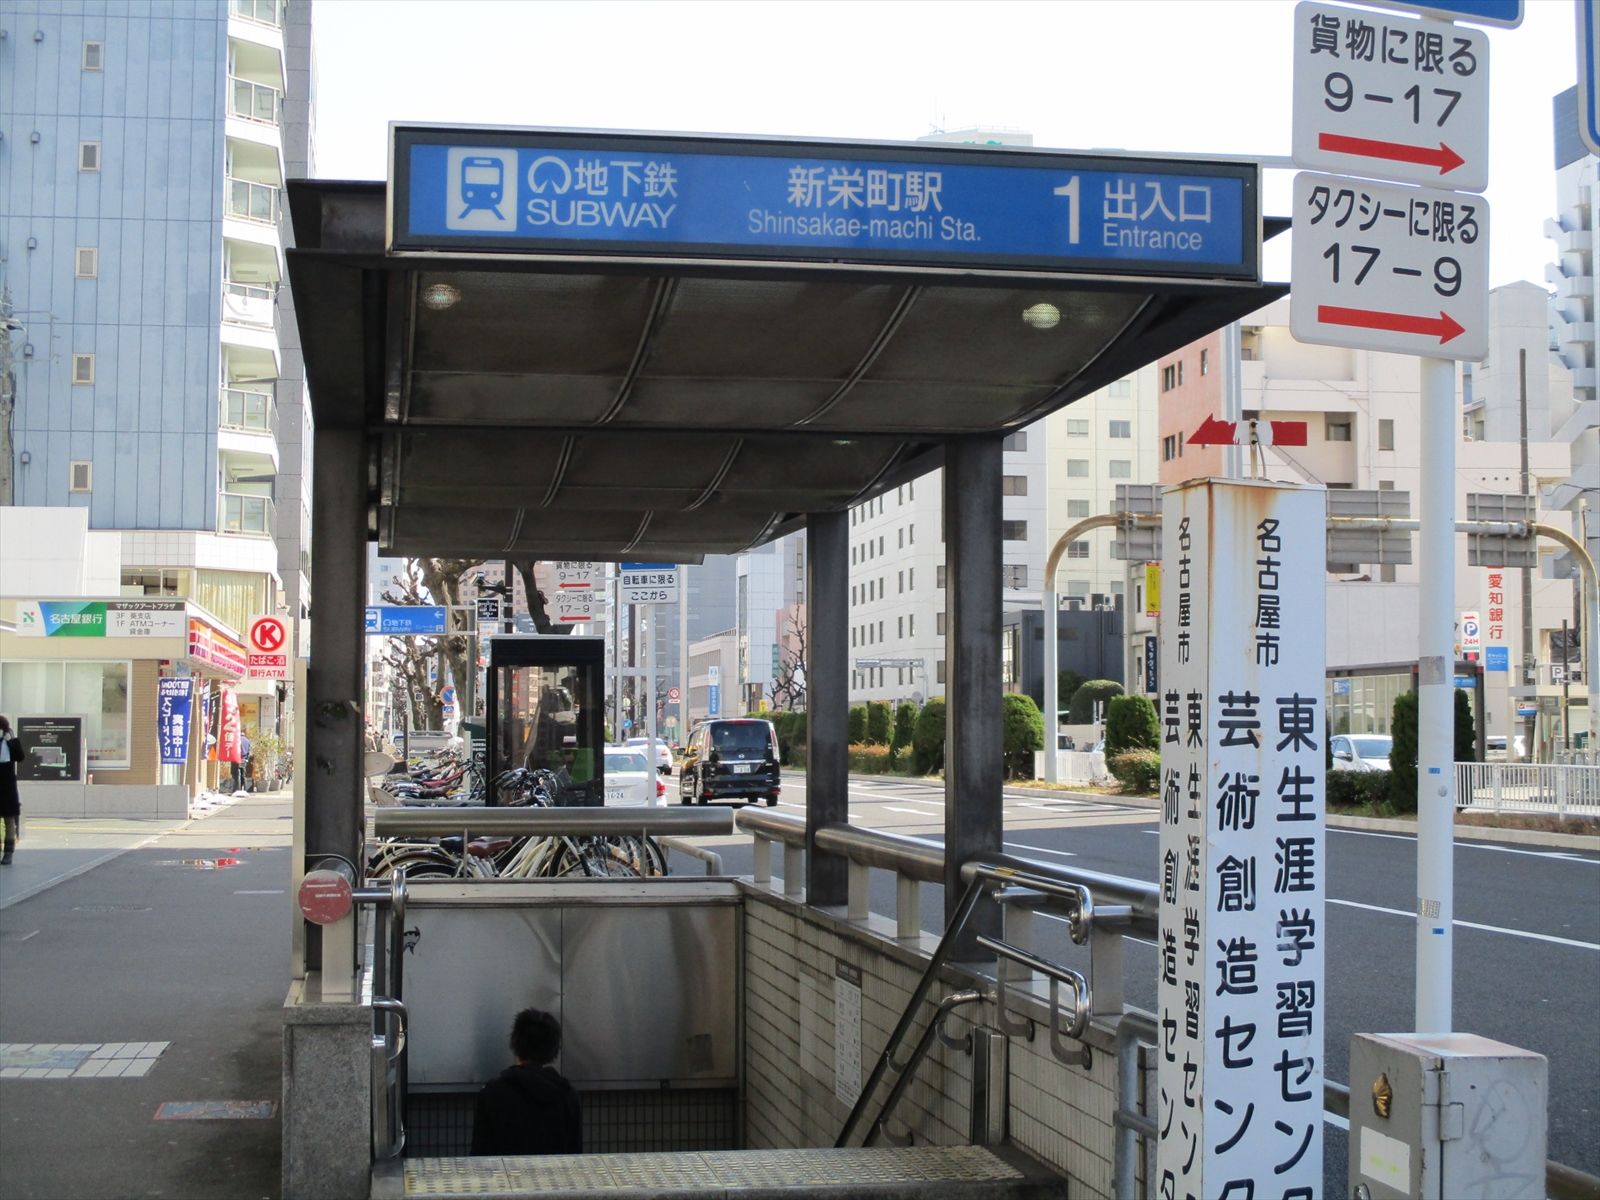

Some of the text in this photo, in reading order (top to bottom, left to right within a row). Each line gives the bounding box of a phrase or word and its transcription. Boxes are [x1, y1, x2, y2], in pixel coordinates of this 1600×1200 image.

[1310, 13, 1477, 77] 貨物に限る
[1324, 72, 1462, 127] 9-17
[574, 158, 678, 199] 地下鉄
[788, 165, 943, 214] 新栄町駅
[1103, 179, 1212, 224] 出入口
[526, 199, 677, 229] SUBWAY
[747, 208, 982, 242] Shinsakae-machi Sta.
[1053, 175, 1081, 245] 1
[1308, 186, 1479, 245] タクシーに限る
[1103, 223, 1202, 251] Entrance
[1323, 243, 1462, 298] 17-9
[555, 593, 594, 603] タクシーに限る
[623, 574, 675, 585] 自転車に限る
[631, 591, 668, 600] ここから
[1178, 516, 1191, 665] 名古屋市
[1255, 518, 1281, 667] 名古屋市
[50, 613, 103, 625] 名古屋銀行
[1488, 573, 1503, 640] 愛知銀行
[1181, 688, 1203, 1200] 東生涯学習セン
[1273, 692, 1318, 1200] 東生涯学習セン
